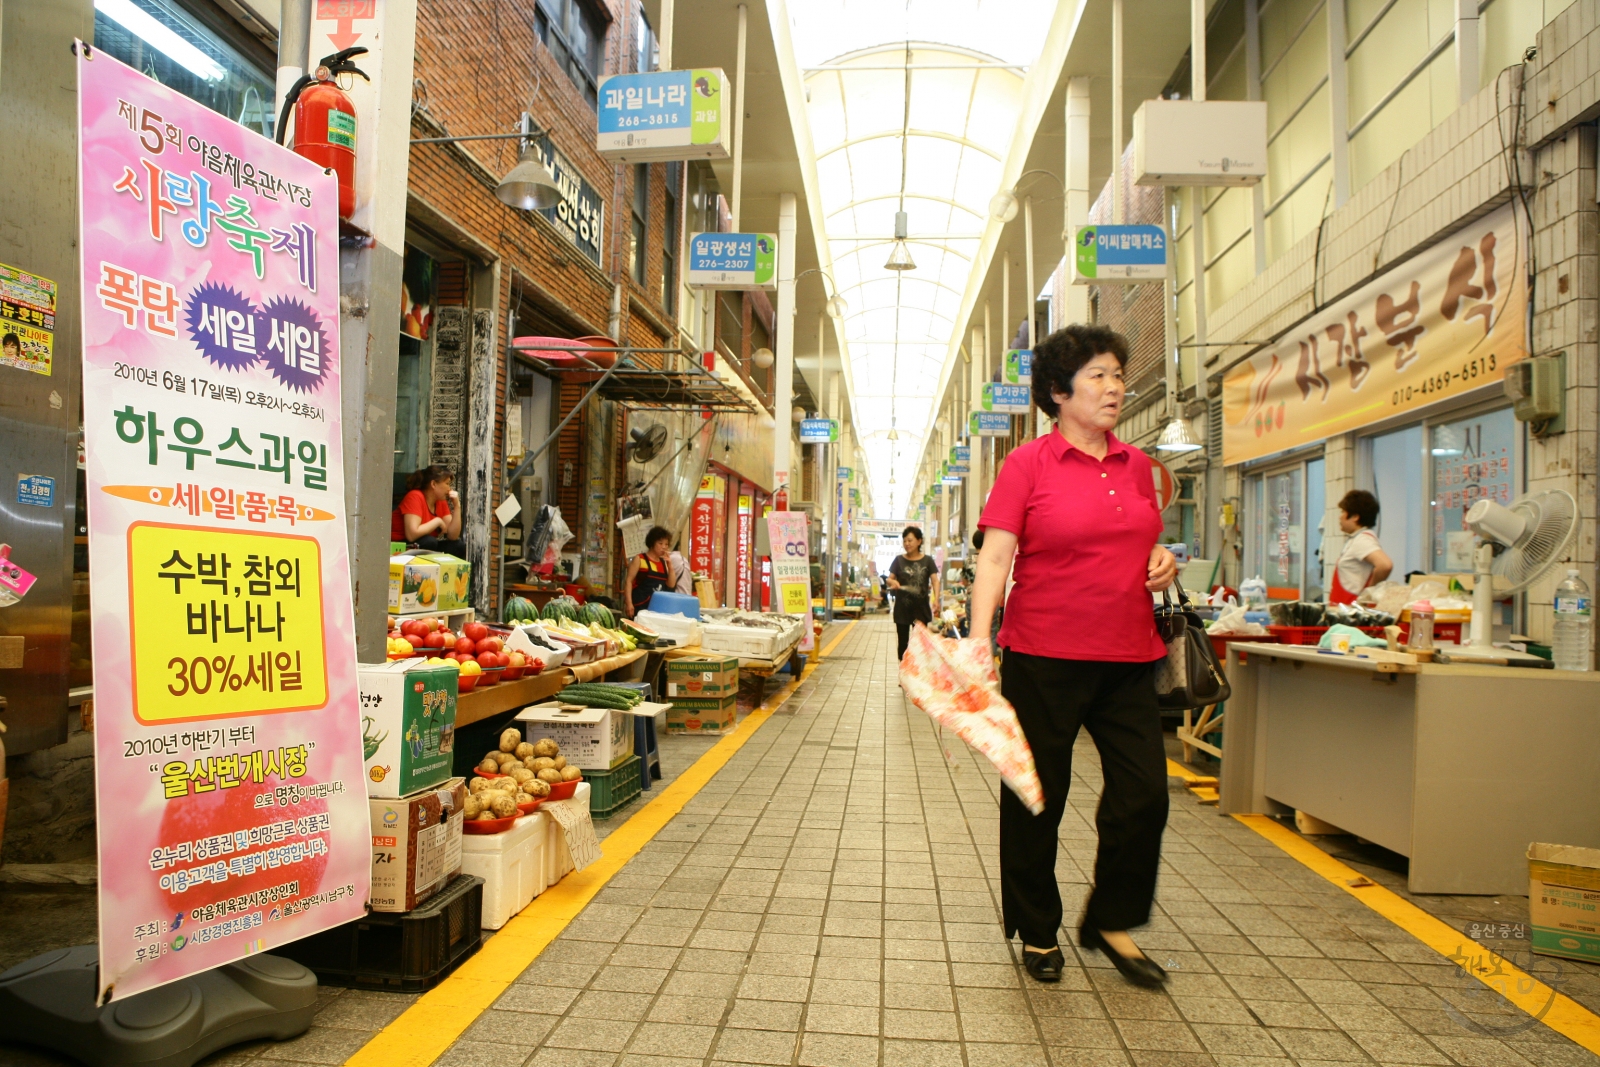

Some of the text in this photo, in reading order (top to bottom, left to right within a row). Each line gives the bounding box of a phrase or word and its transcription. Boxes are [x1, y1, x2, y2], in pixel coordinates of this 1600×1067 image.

[605, 84, 687, 111] 과일나라
[694, 110, 718, 123] 과일
[618, 114, 678, 127] 268-3815
[117, 98, 311, 208] 제5회 야음체육관시장
[114, 157, 316, 292] 사랑축제
[1098, 234, 1163, 250] 이씨할매채소
[696, 240, 751, 256] 일광생선
[699, 259, 749, 268] 276-2307
[99, 265, 180, 338] 폭탄
[198, 303, 257, 355] 세일
[266, 317, 321, 376] 세일
[1295, 231, 1496, 403] 시장분식
[114, 362, 325, 423] 2010년 6월 17일(목) 오후2시~오후5시
[1392, 354, 1497, 406] 010-4369-6513
[113, 405, 328, 491] 하우스과일
[172, 482, 298, 526] 세일품목
[158, 550, 301, 598] 수박,참외
[186, 600, 286, 643] 바나나
[167, 650, 303, 697] 30%세일
[123, 725, 256, 758] 2010년 하반기 부터
[254, 794, 273, 809] 으로
[149, 814, 330, 870] 온누리 상품권 및 희망근로 상품권
[160, 841, 328, 894] 이용고객을 특별히 환영합니다.
[192, 882, 299, 923] 야음체육관시장상인회
[1582, 904, 1596, 912] 102
[189, 912, 263, 945] 시장경영진흥원
